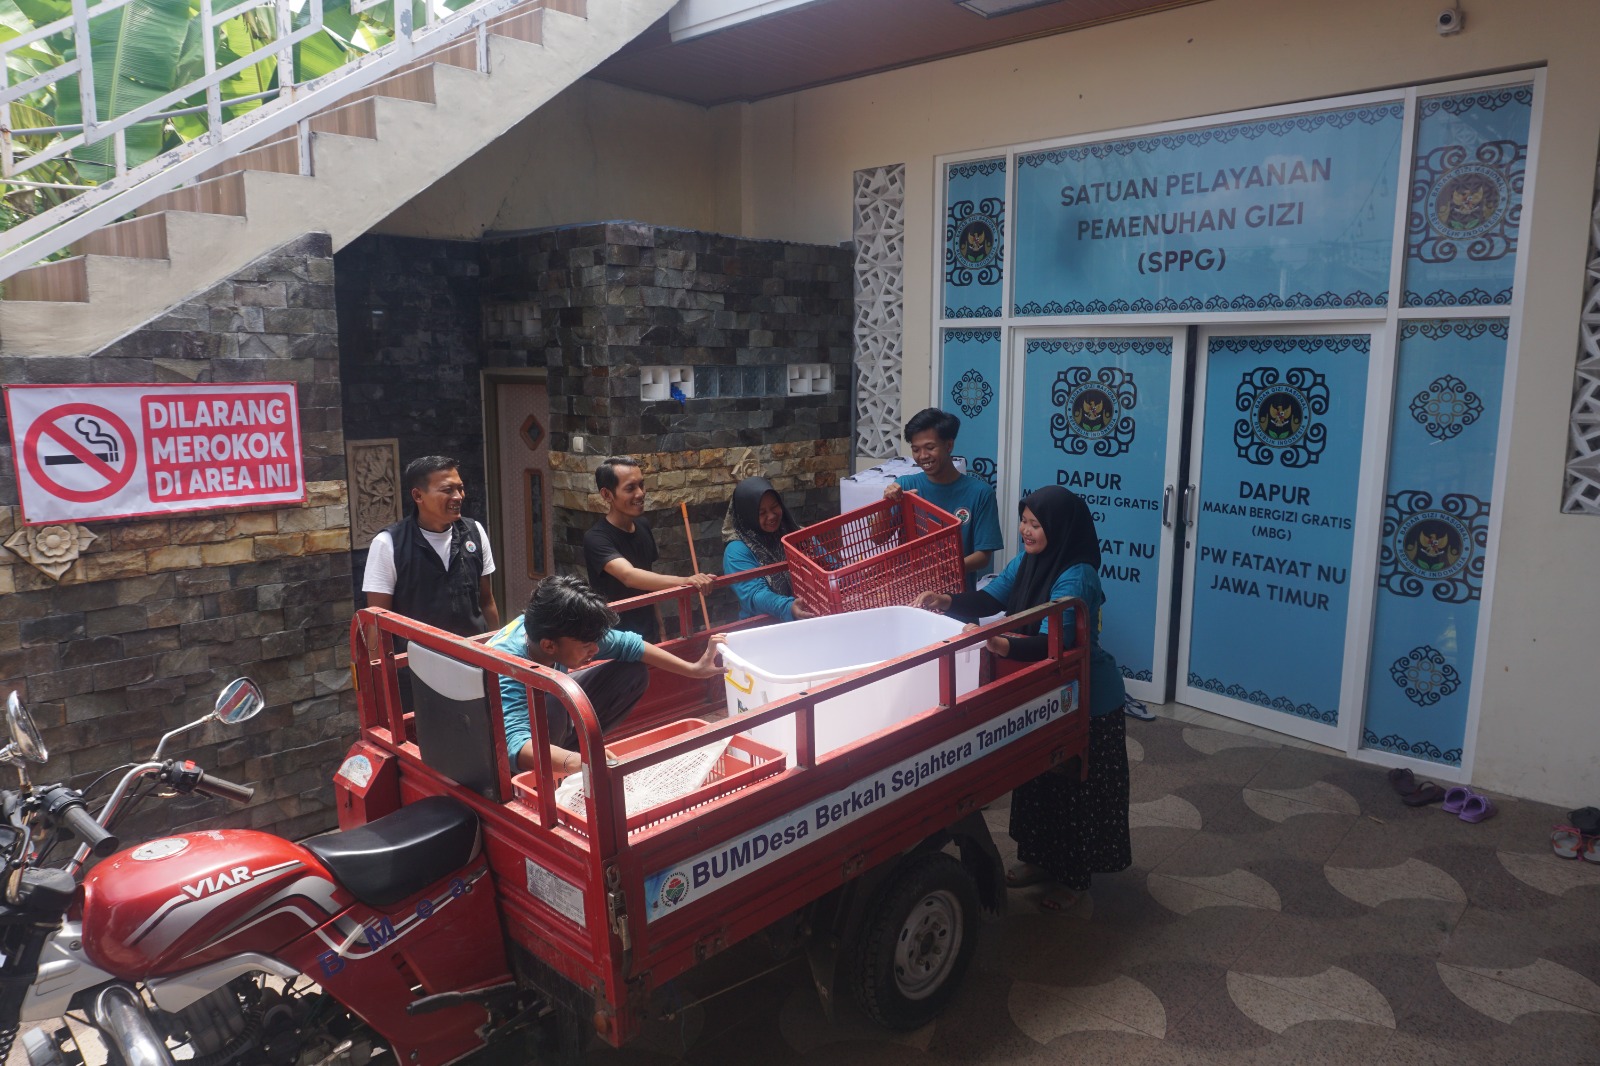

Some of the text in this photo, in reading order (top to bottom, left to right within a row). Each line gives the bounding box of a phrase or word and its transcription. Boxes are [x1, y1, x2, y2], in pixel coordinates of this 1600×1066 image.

[1061, 157, 1332, 207] SATUAN PELAYANAN
[1077, 201, 1304, 241] PEMENUHAN GIZI
[1138, 247, 1226, 275] (SPPG)
[148, 399, 286, 430] DILARANG
[152, 431, 288, 465] MEROKOK
[155, 463, 291, 497] DI AREA INI
[1056, 469, 1122, 491] DAPUR
[1239, 480, 1311, 506] DAPUR
[1114, 496, 1159, 511] GRATIS
[1202, 501, 1352, 530] MAKAN BERGIZI GRATIS
[1251, 525, 1292, 542] (MBG)
[1129, 542, 1155, 559] NU
[1200, 546, 1347, 585] PW FATAYAT NU
[1100, 563, 1141, 583] MUR
[1210, 574, 1330, 611] JAWA TIMUR
[692, 819, 809, 890] BUMDesa
[815, 780, 886, 830] Berkah
[891, 741, 972, 793] Sejahtera
[976, 697, 1060, 751] Tambakrejo
[182, 865, 252, 899] VIAR
